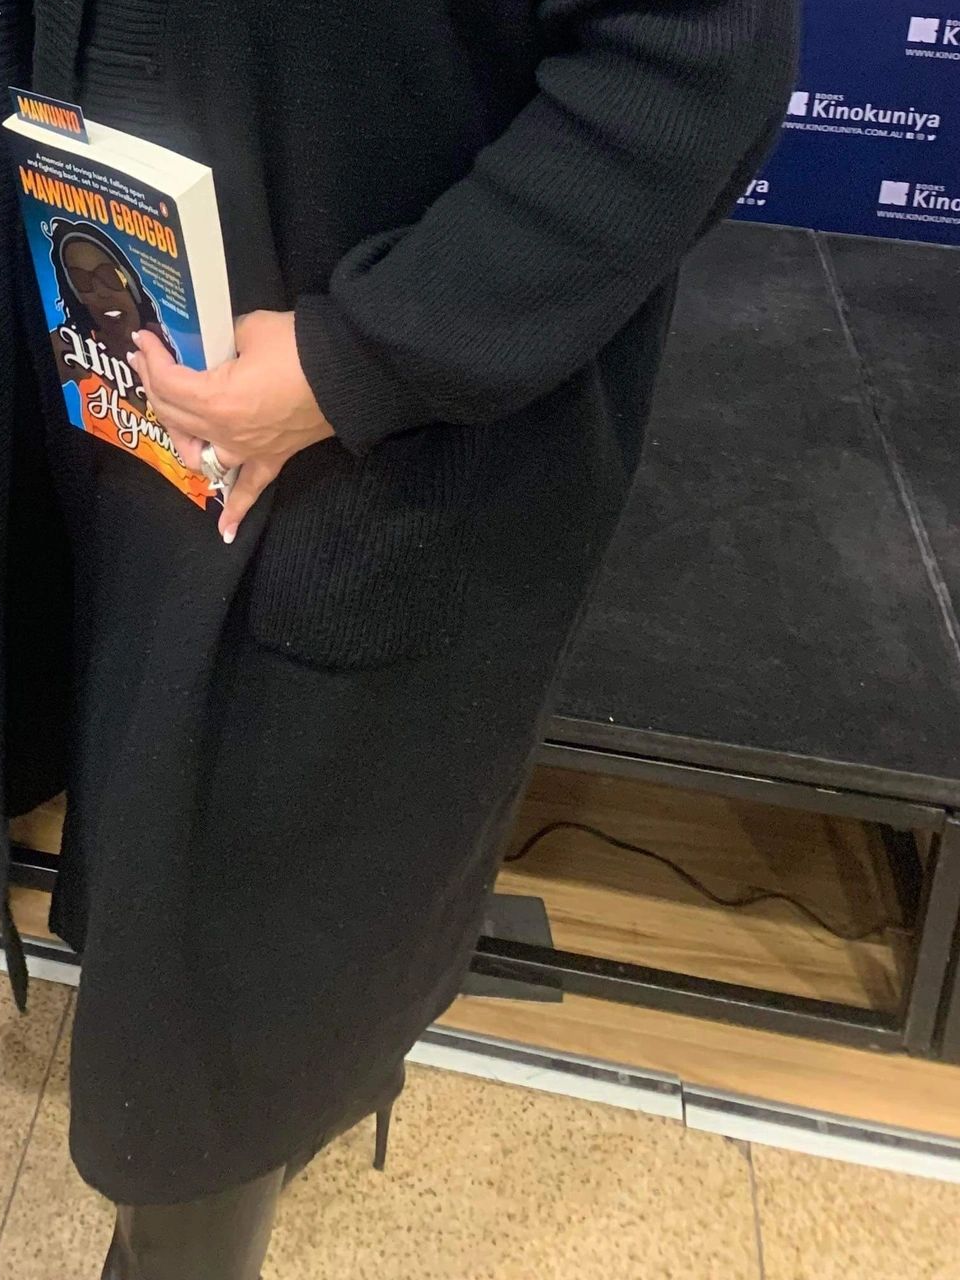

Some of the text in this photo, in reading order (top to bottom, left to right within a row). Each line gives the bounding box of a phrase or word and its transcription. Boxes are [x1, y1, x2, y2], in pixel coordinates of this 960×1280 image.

[17, 95, 81, 134] MAWUNYO
[812, 100, 940, 132] Kinokuniya
[18, 165, 178, 260] MAWUNYO GBOGBO
[59, 323, 135, 398] Hip
